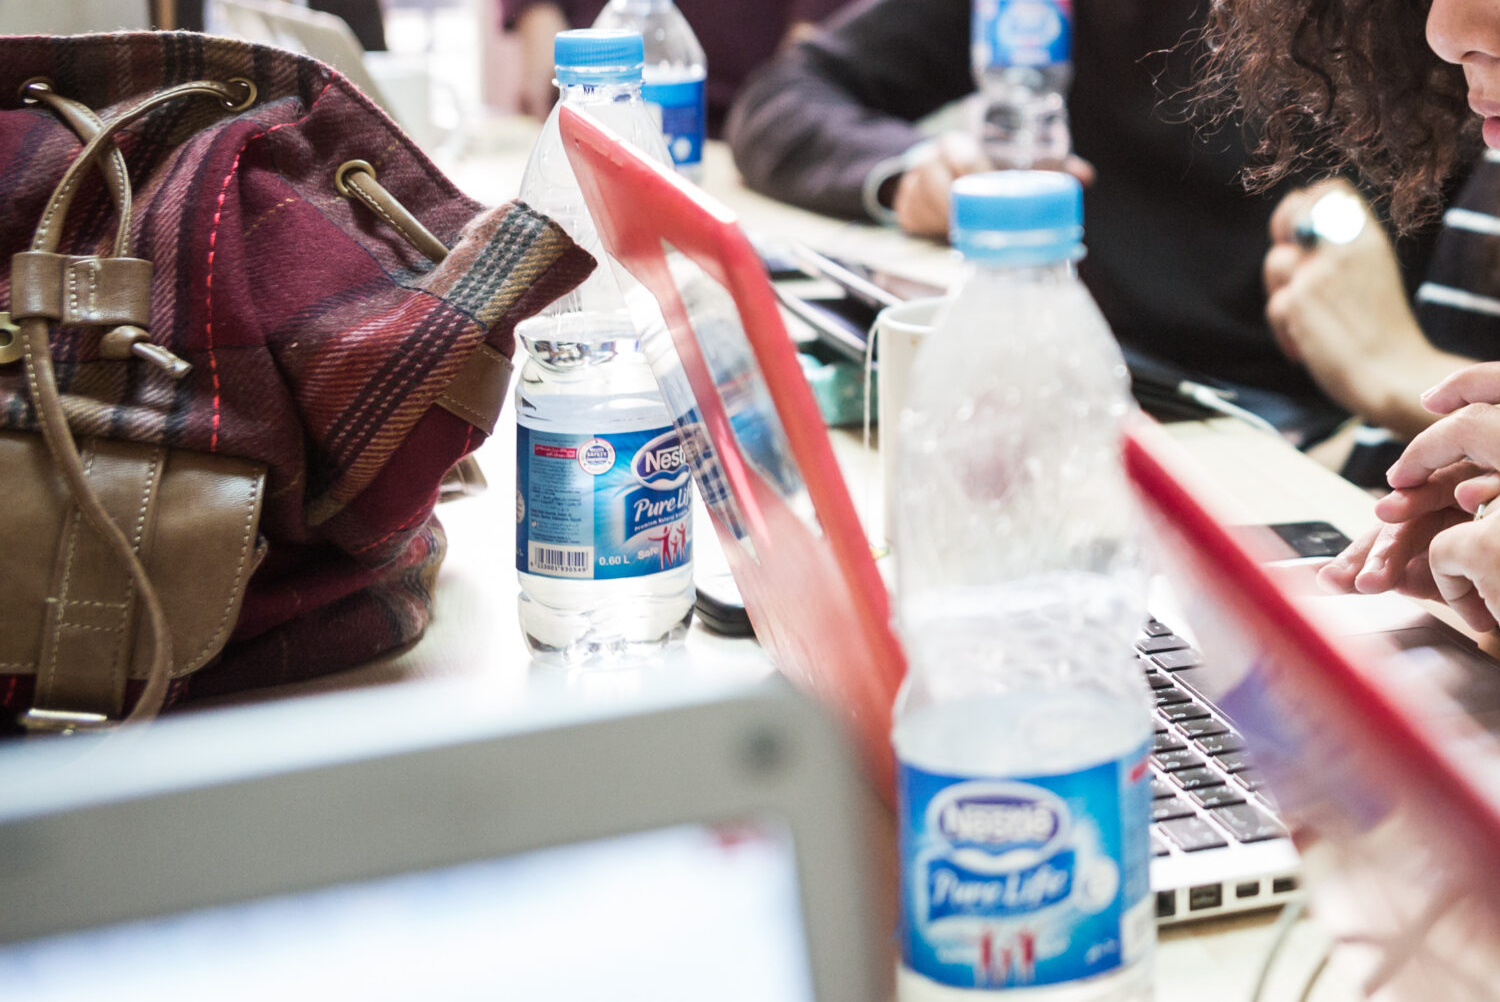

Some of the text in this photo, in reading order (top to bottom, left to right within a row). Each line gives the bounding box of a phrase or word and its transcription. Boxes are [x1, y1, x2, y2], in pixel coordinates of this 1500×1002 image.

[645, 445, 686, 473] Nest
[633, 497, 677, 523] Pure
[677, 484, 691, 509] Lif
[599, 555, 630, 567] 0.60 L
[932, 868, 1003, 907] Pure
[1002, 864, 1070, 907] Life
